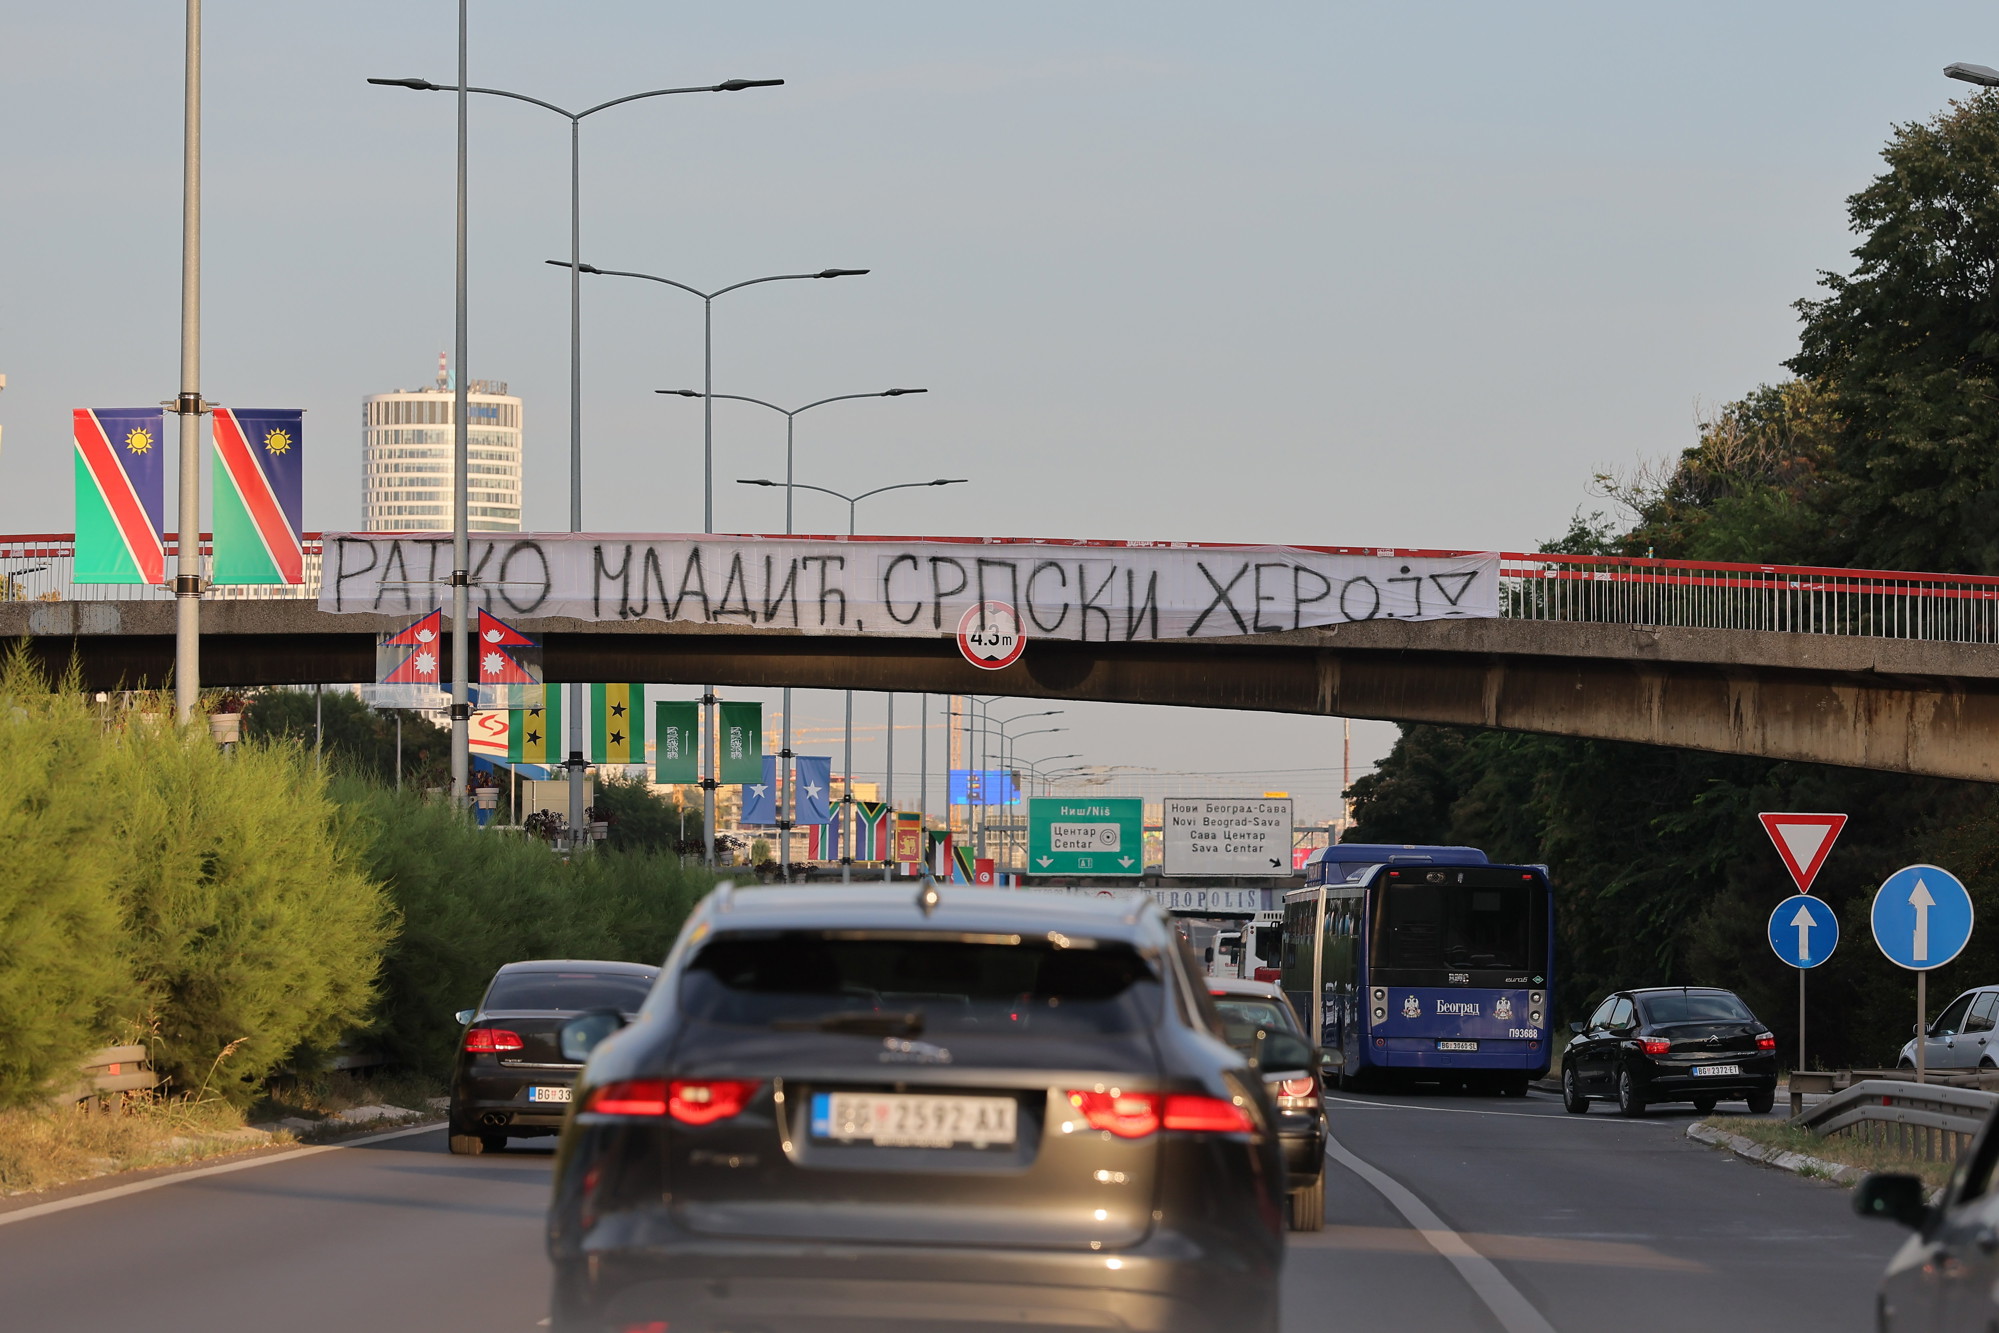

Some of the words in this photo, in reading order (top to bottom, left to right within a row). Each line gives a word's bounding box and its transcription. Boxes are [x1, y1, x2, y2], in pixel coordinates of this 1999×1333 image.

[333, 537, 551, 614] РАТКО
[884, 554, 1159, 641] СРПСКИ
[970, 624, 1000, 646] 4.3
[1002, 635, 1012, 646] m
[1061, 806, 1111, 816] Ниш/Niš
[1171, 804, 1198, 813] Нови
[1206, 804, 1287, 815] Београд-Сава
[1172, 817, 1196, 826] Novi
[1203, 817, 1280, 828] Beograd-Sava
[1054, 826, 1096, 837] Центар
[1190, 830, 1217, 840] Сава
[1223, 830, 1266, 841] Центар
[1054, 838, 1093, 849] Centar
[1192, 843, 1218, 853] Sava
[1225, 843, 1264, 853] Centar
[1436, 999, 1480, 1016] Београд
[1508, 1028, 1538, 1038] П93688
[538, 1089, 550, 1100] BG
